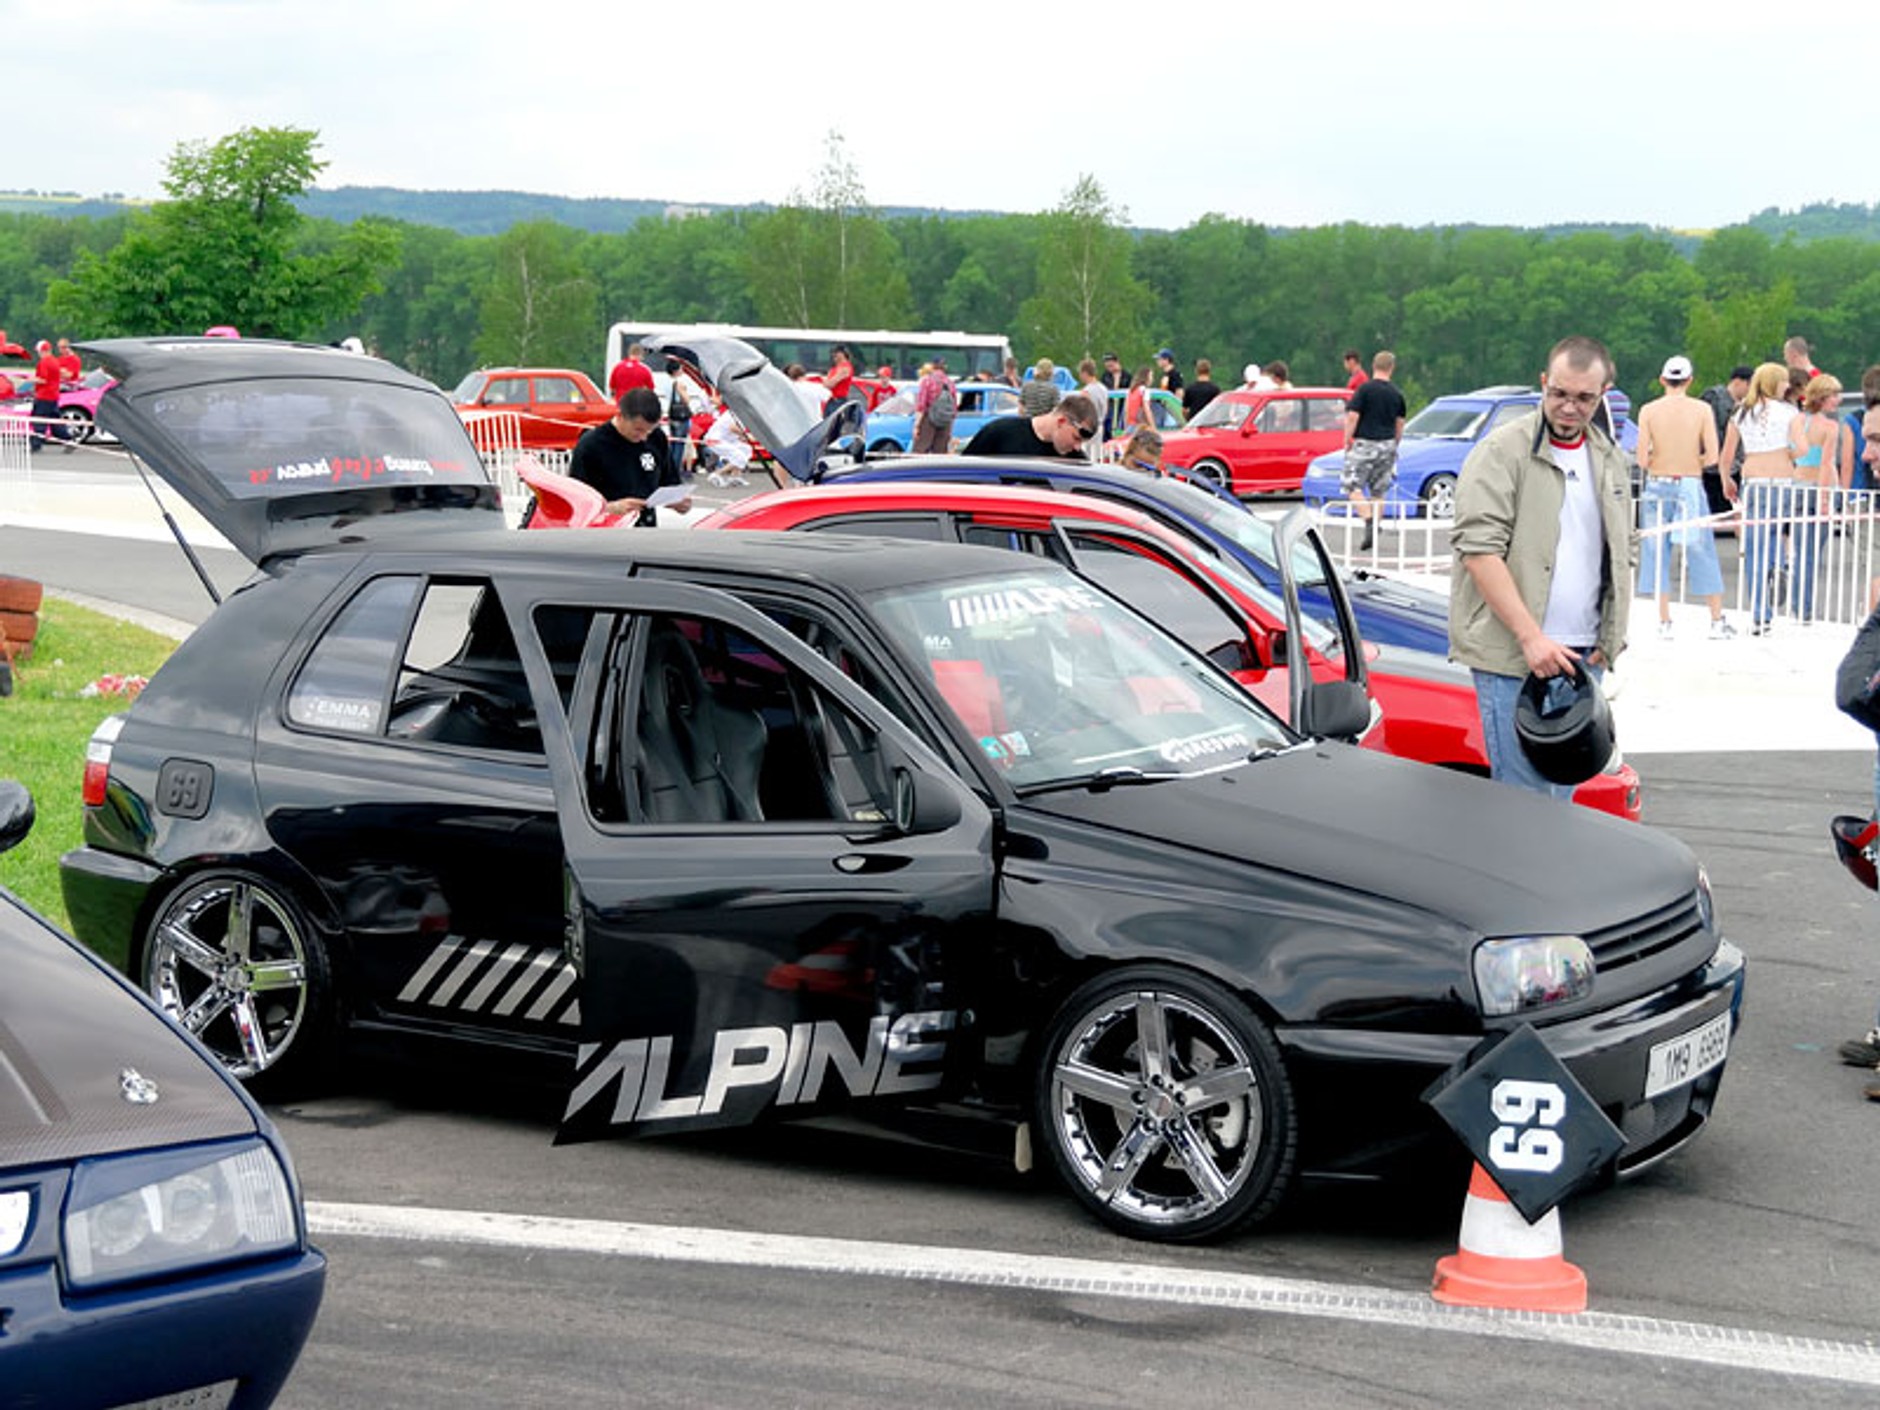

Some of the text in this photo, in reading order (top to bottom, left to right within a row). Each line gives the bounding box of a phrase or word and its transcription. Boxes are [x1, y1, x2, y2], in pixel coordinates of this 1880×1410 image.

[317, 700, 371, 718] EMMA
[168, 770, 203, 810] 69
[562, 1010, 957, 1125] ALPINE
[1665, 1042, 1691, 1085] 1M9
[1487, 1079, 1567, 1173] 69
